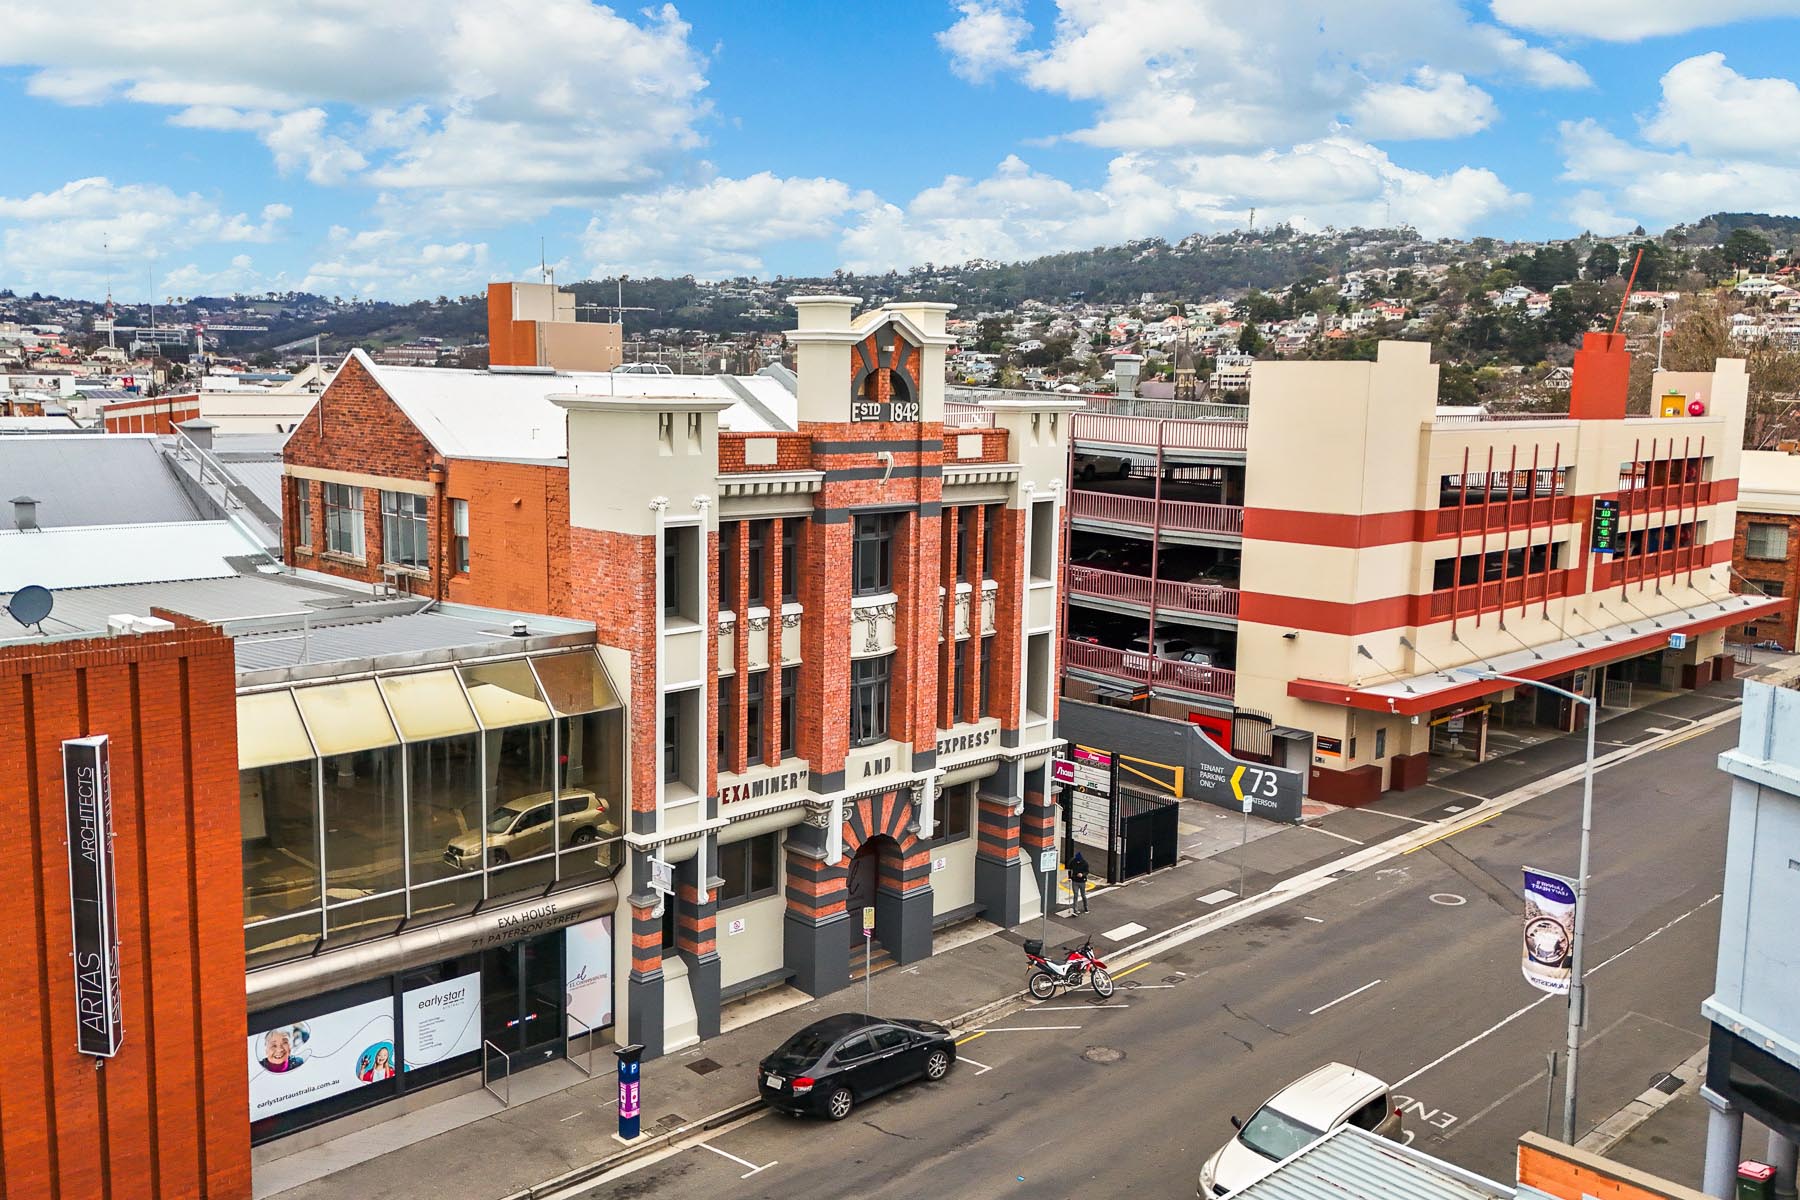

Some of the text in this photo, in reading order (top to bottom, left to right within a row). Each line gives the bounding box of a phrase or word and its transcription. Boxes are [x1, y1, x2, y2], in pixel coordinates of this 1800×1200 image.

[889, 402, 919, 422] 1842
[863, 756, 891, 777] AND
[1199, 771, 1226, 783] PARKING
[1200, 762, 1225, 774] TENANT
[1199, 780, 1216, 789] ONLY
[1249, 768, 1278, 797] 73
[1252, 797, 1278, 809] ATERSON
[77, 766, 96, 862] ARCHITECTS
[497, 904, 558, 929] EXA HOUSE
[471, 911, 581, 950] 71 PATERSON STREET
[78, 952, 106, 1034] ARTAS
[621, 1062, 626, 1071] P
[631, 1063, 637, 1073] P
[257, 1079, 340, 1108] earlystartaustralia.com.au
[1391, 1095, 1458, 1129] END
